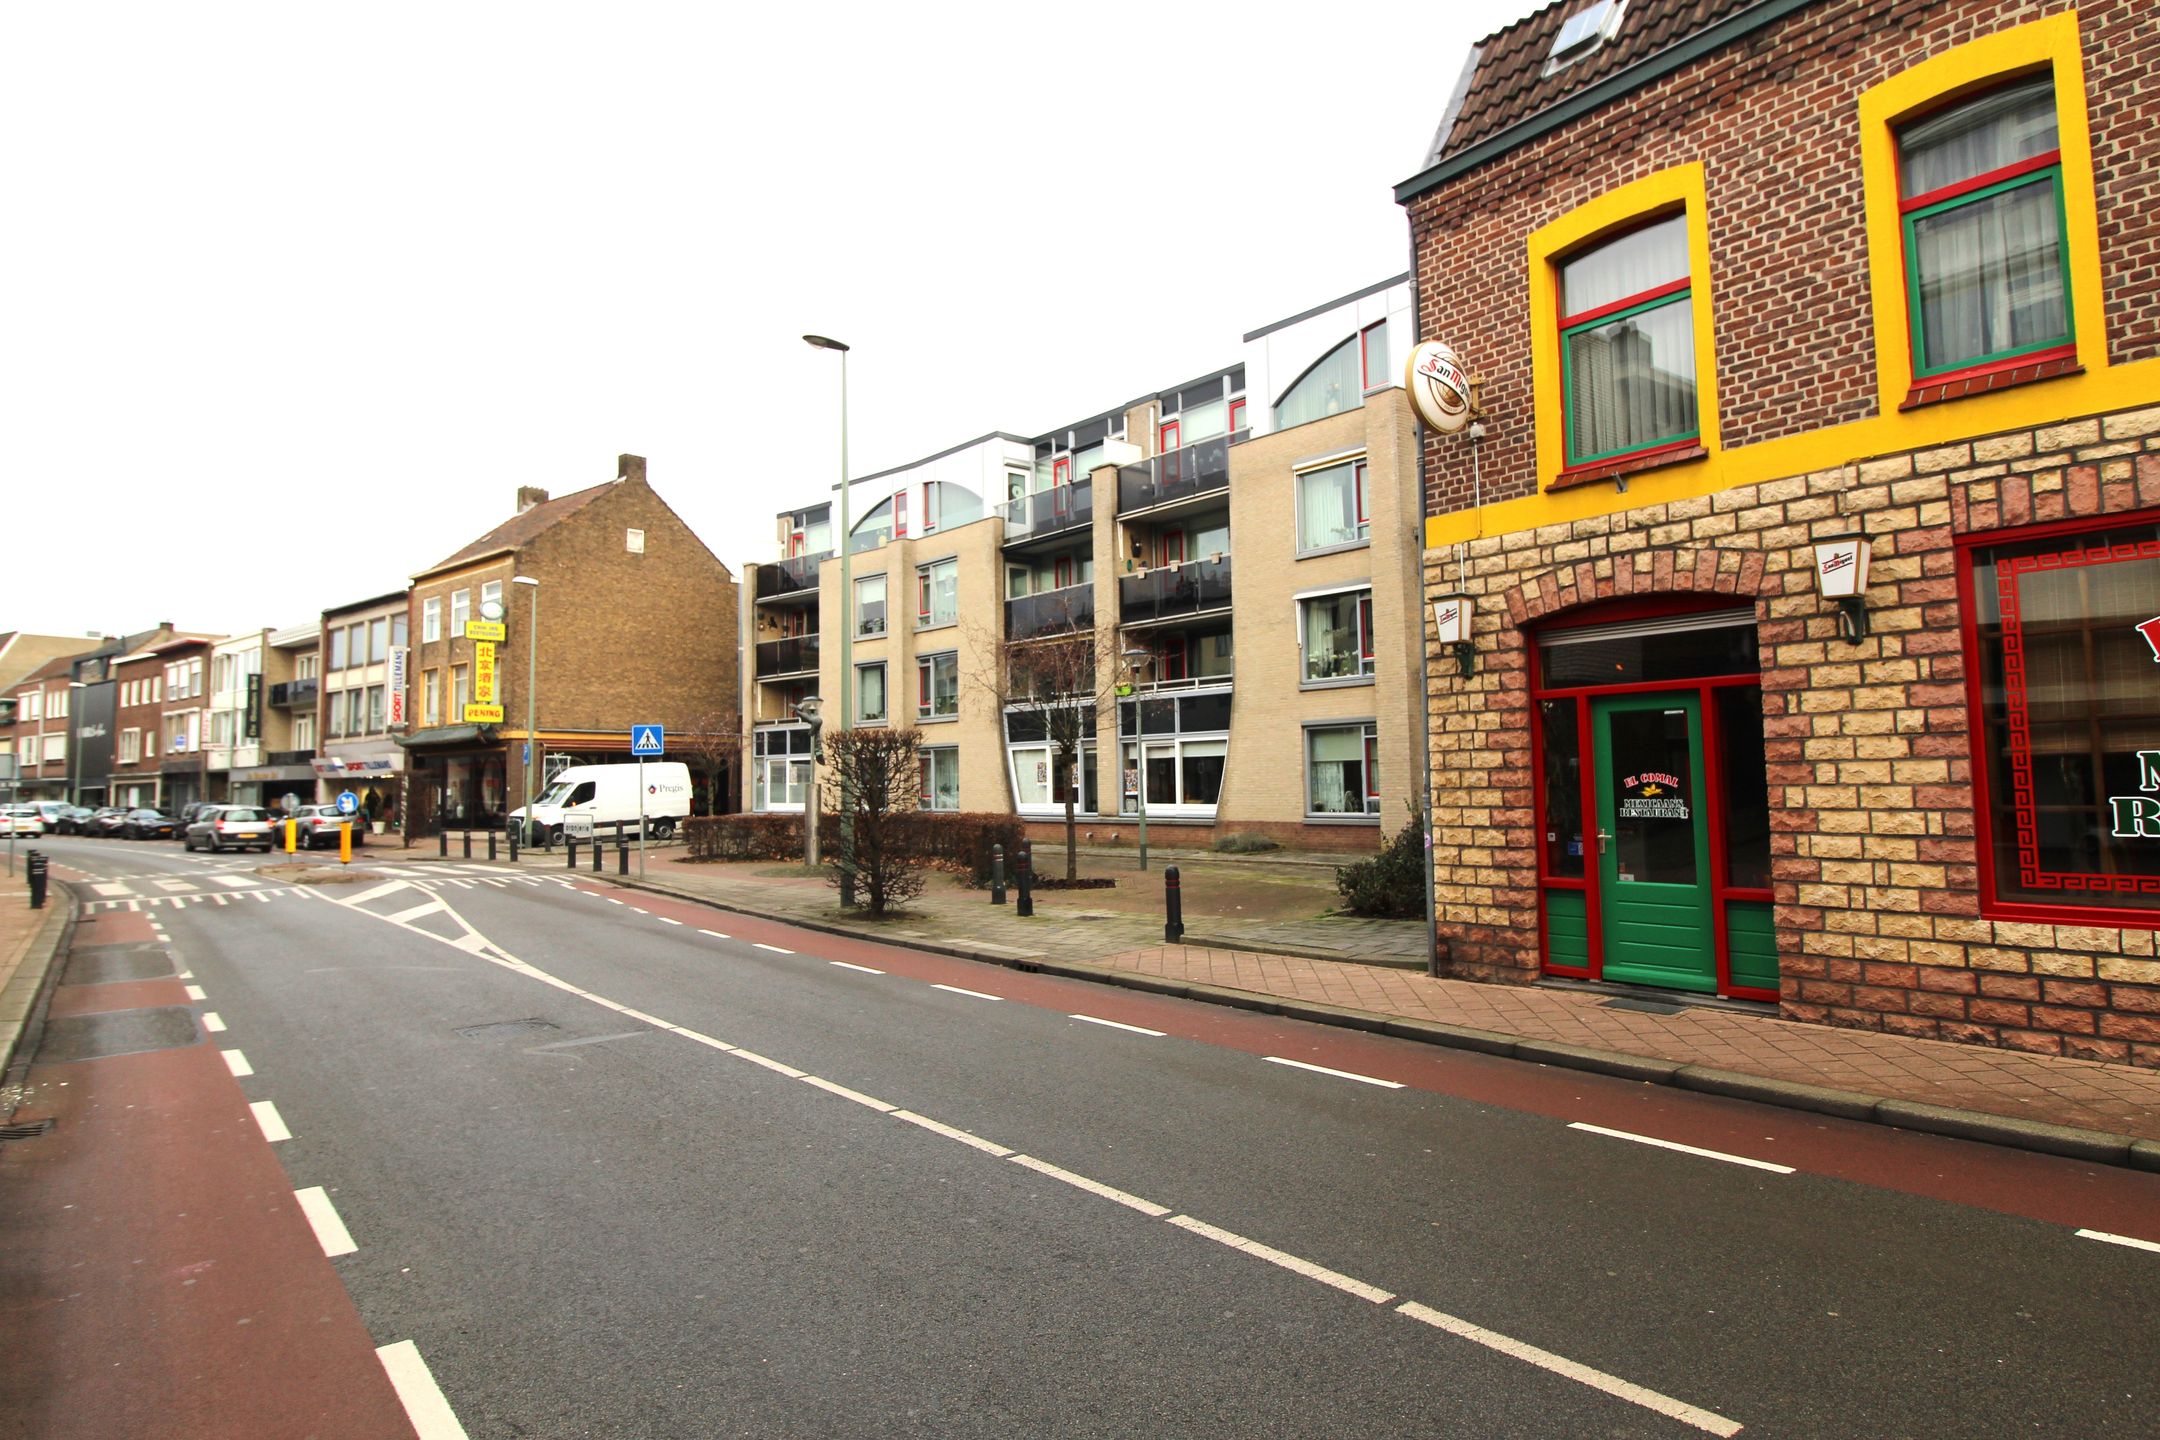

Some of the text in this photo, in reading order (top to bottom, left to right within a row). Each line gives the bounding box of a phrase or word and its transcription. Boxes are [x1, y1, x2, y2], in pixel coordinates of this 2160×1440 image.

[1421, 359, 1470, 402] San Migu
[393, 692, 402, 722] SPORT
[1624, 772, 1679, 788] EL COMAL
[659, 783, 684, 794] Pregis
[1623, 798, 1684, 808] MEXICAANS
[1620, 808, 1689, 819] RESTAURANT
